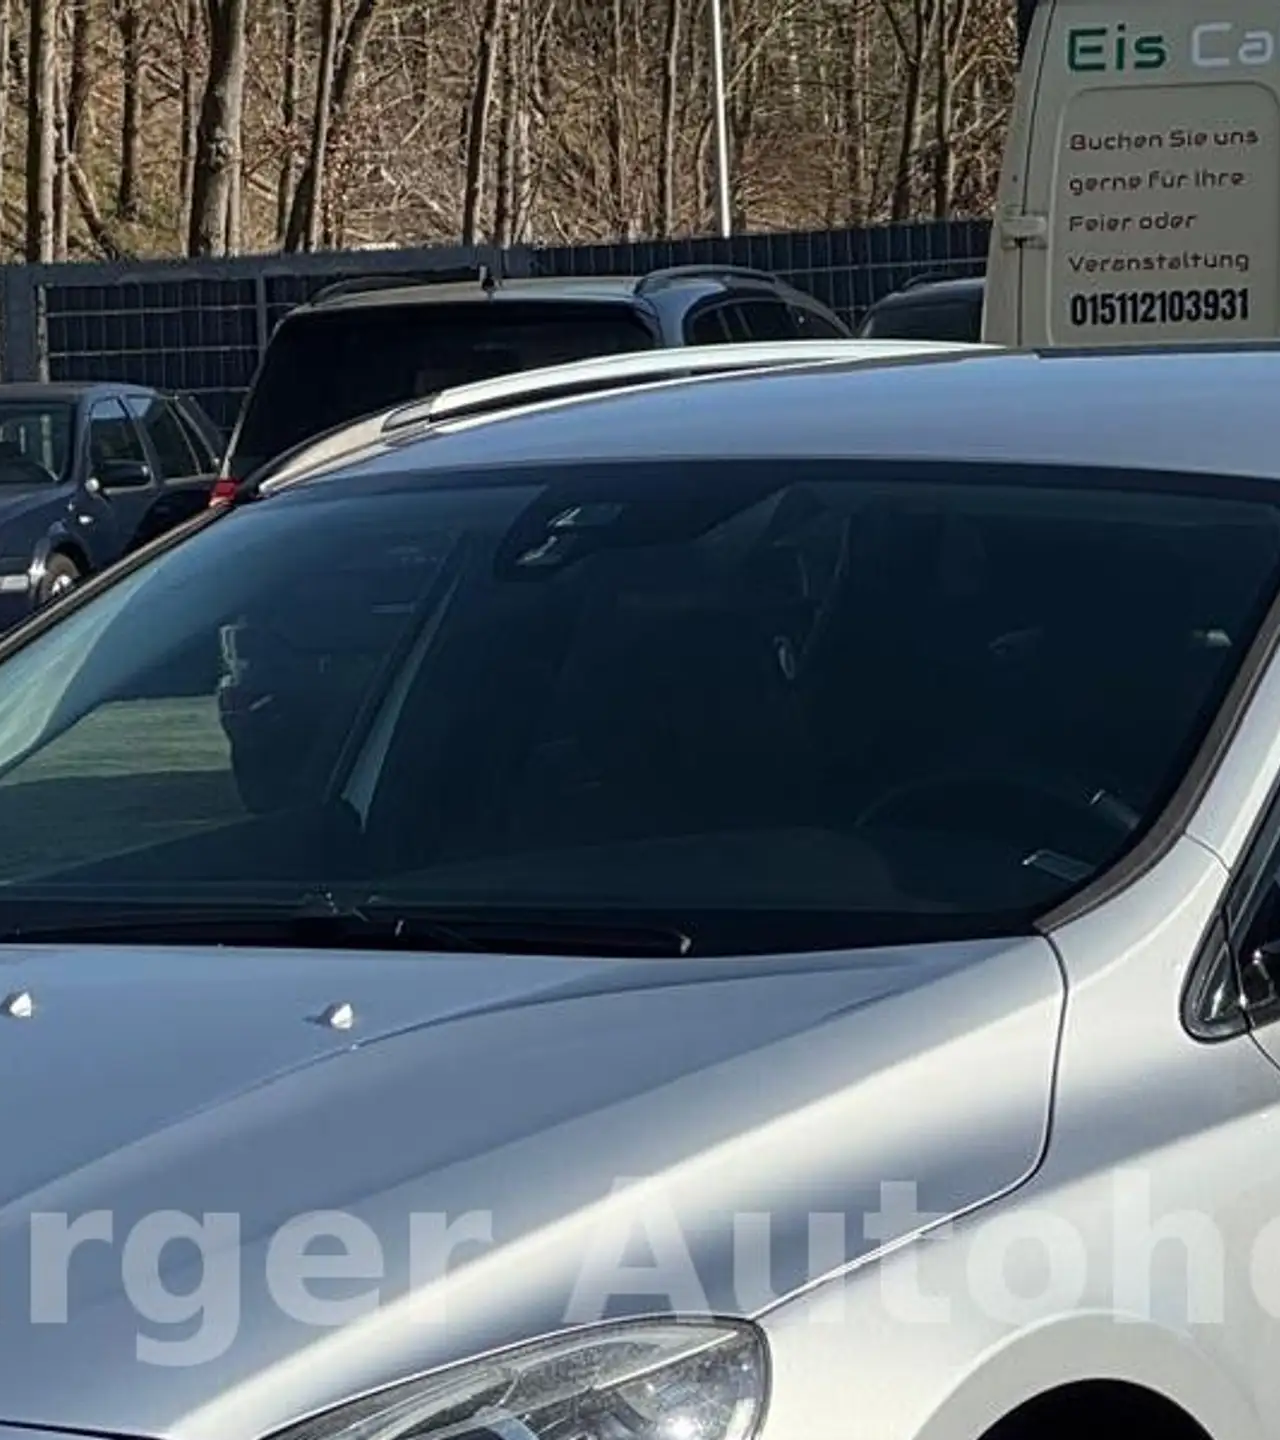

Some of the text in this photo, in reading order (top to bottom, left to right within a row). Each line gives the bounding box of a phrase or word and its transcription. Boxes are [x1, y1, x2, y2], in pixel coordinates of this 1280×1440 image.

[1067, 23, 1167, 71] Eis
[1070, 128, 1259, 151] Buchen Sie uns
[1068, 168, 1245, 196] gerne für Ihre
[1069, 211, 1198, 232] Feier oder
[1068, 251, 1250, 273] Veranstaltung
[1070, 287, 1250, 327] 015112103931
